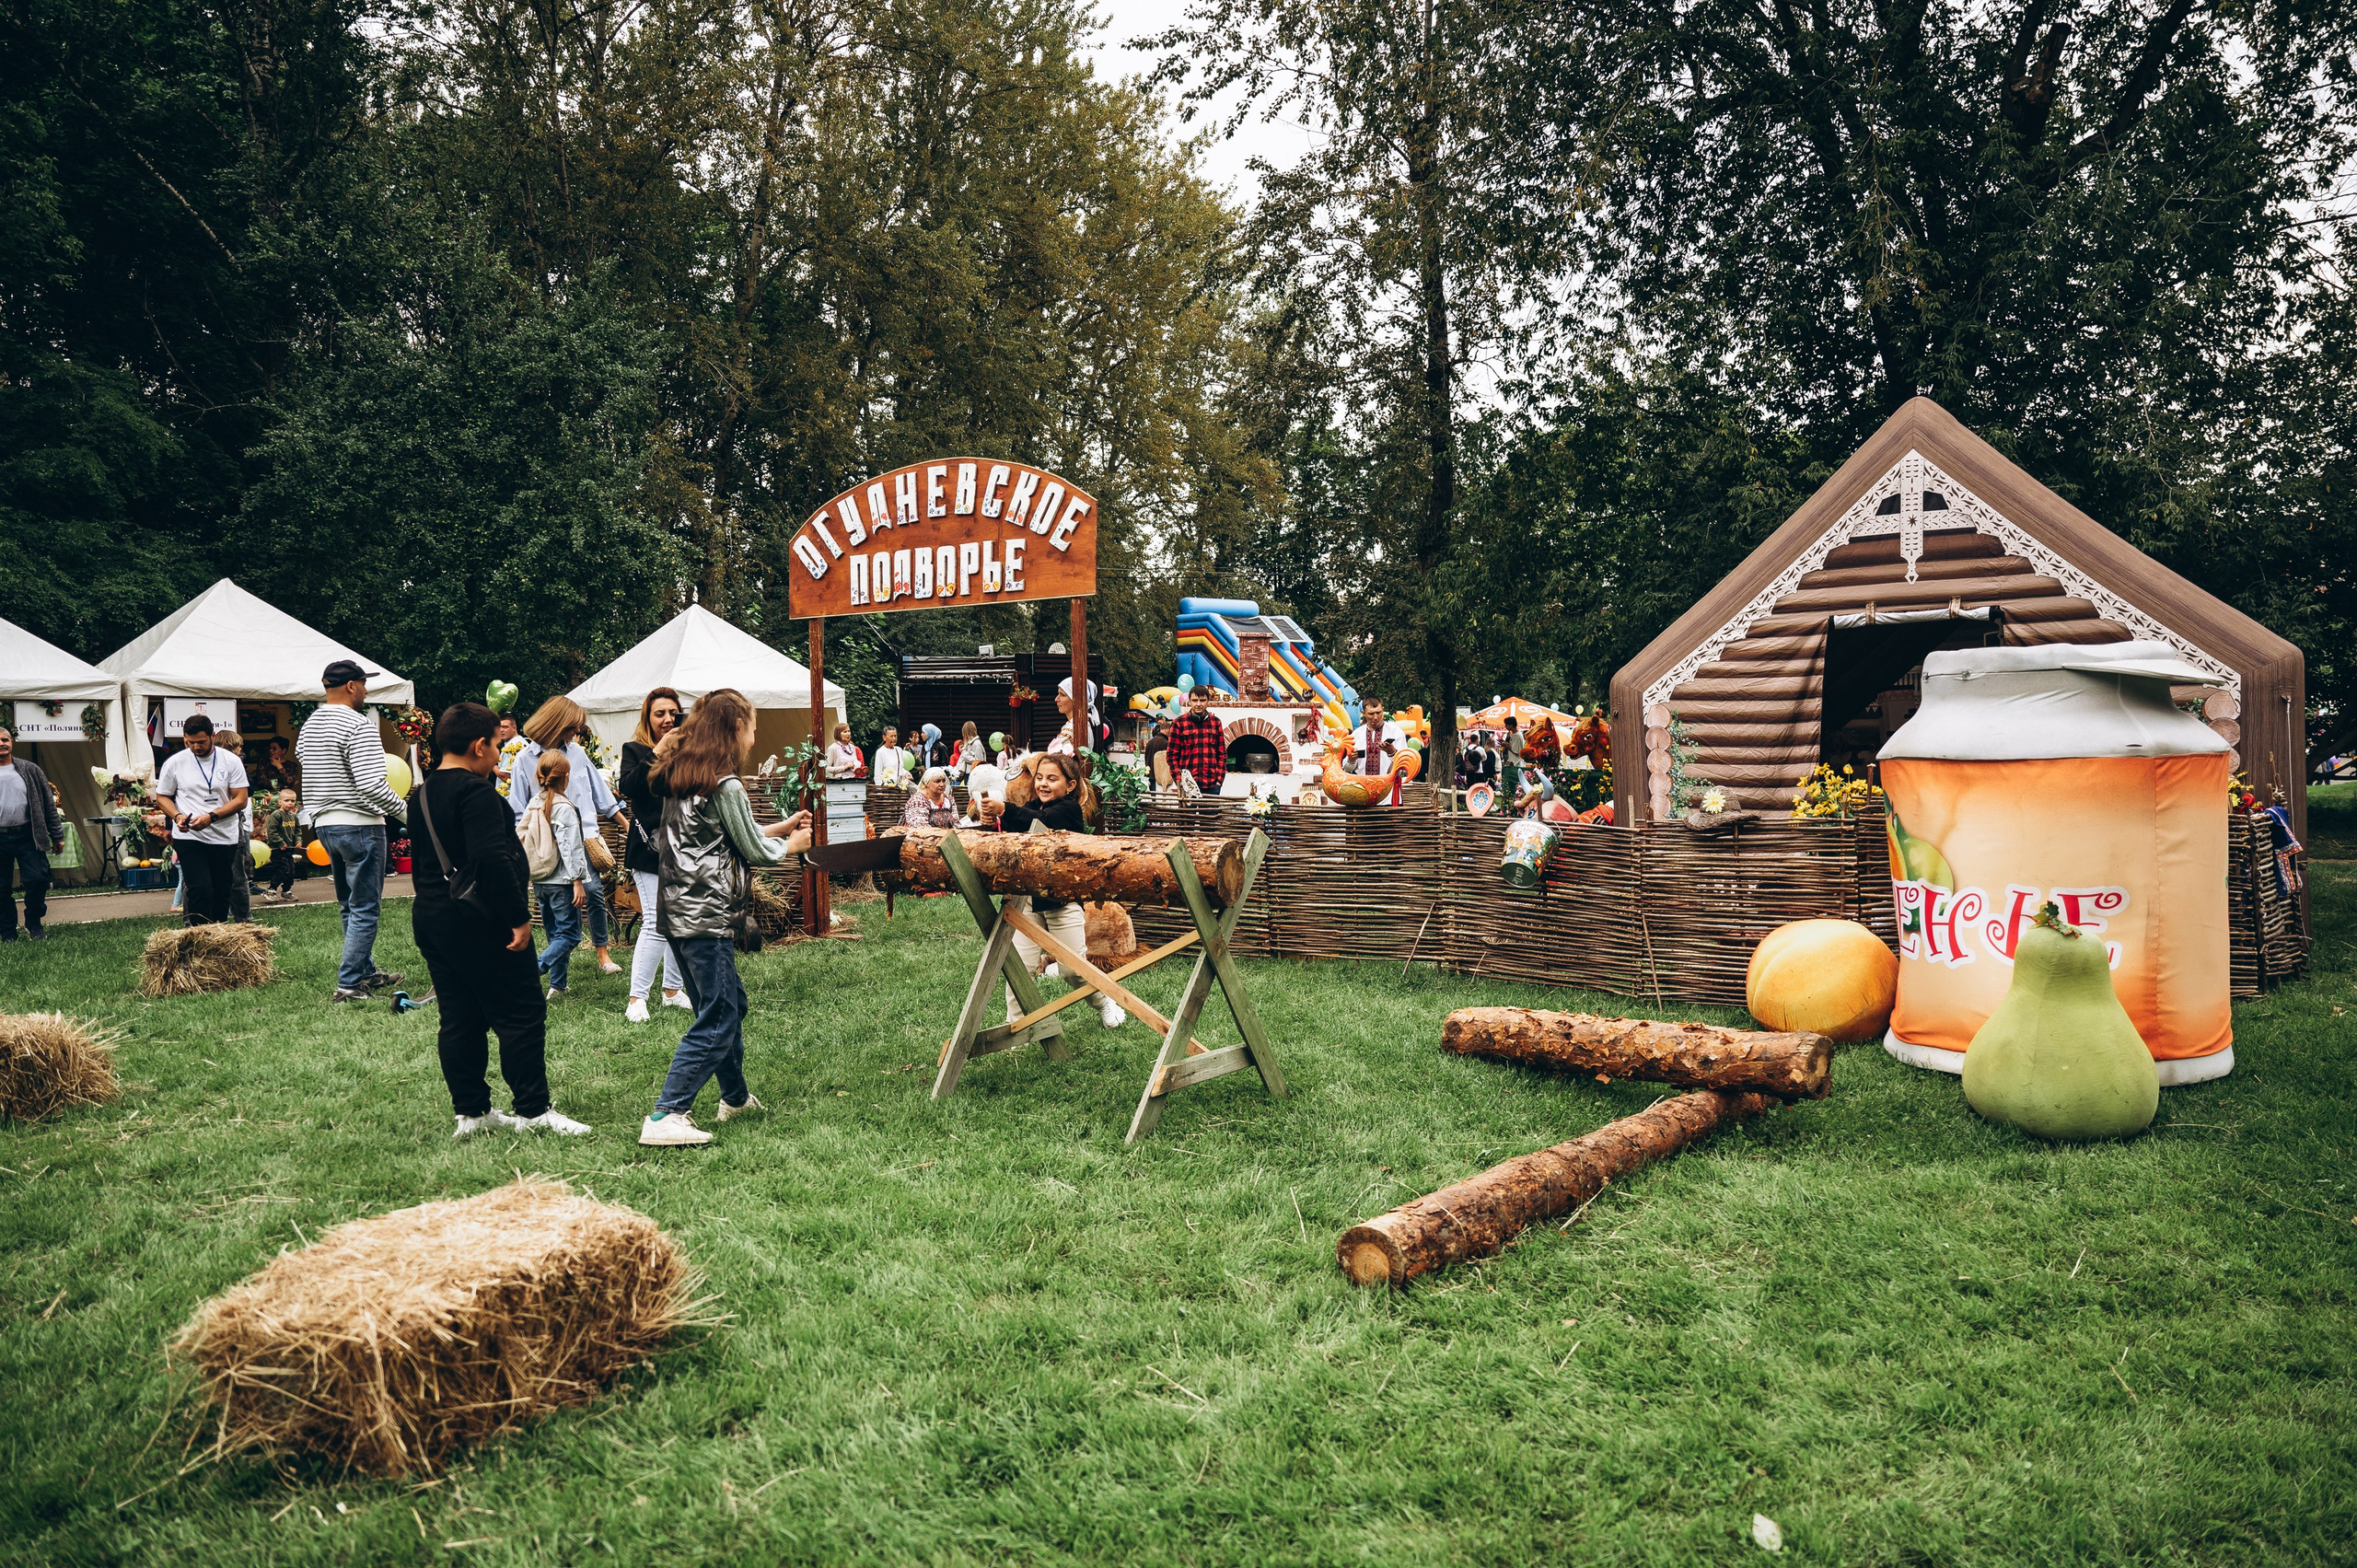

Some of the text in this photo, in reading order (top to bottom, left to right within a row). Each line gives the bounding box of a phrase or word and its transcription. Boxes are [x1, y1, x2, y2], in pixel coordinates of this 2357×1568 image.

[793, 463, 1091, 580] ОГУДНЕВСКОЕ
[849, 539, 1027, 606] ПОДВОРЬЕ
[18, 724, 85, 733] СНТ «Полянк
[168, 720, 185, 728] СН
